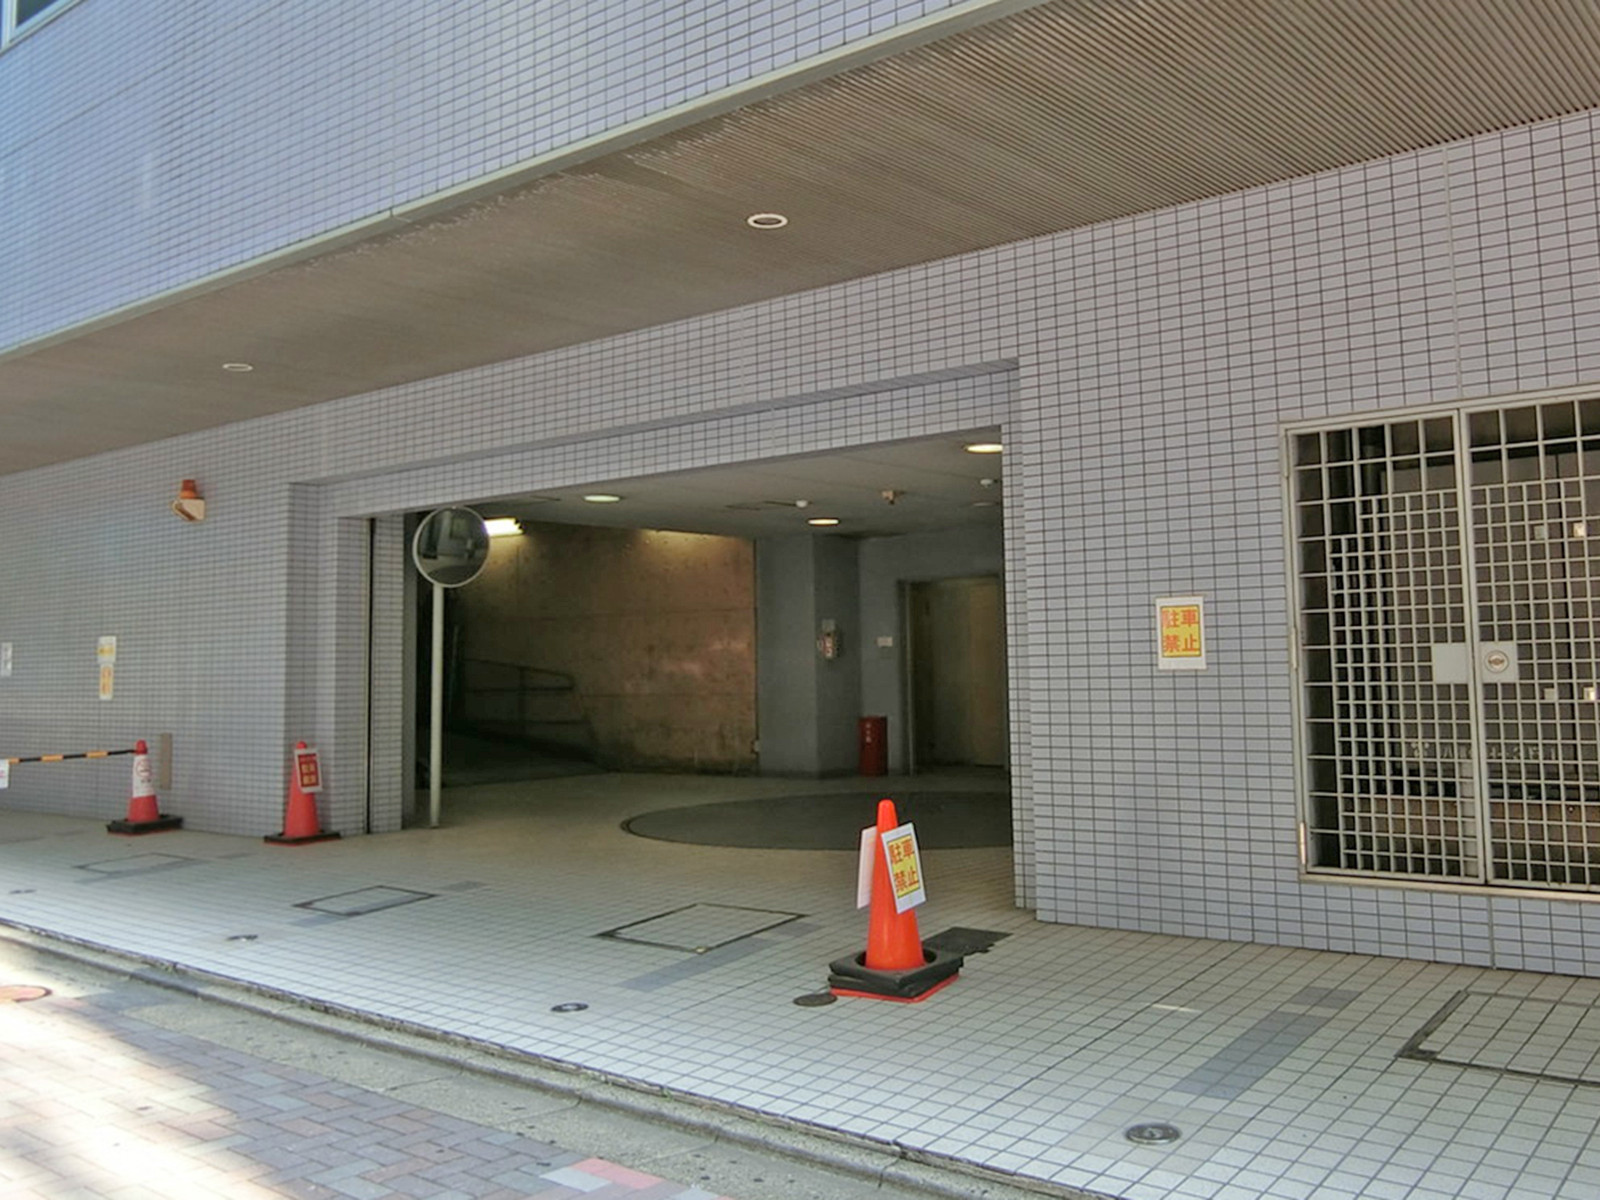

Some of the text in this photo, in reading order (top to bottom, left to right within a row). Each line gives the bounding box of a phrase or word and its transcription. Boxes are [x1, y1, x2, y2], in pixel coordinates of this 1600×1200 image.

[1161, 610, 1199, 628] 駐車
[1163, 634, 1201, 653] 禁止
[888, 839, 915, 865] 駐車
[895, 866, 919, 893] 禁止
